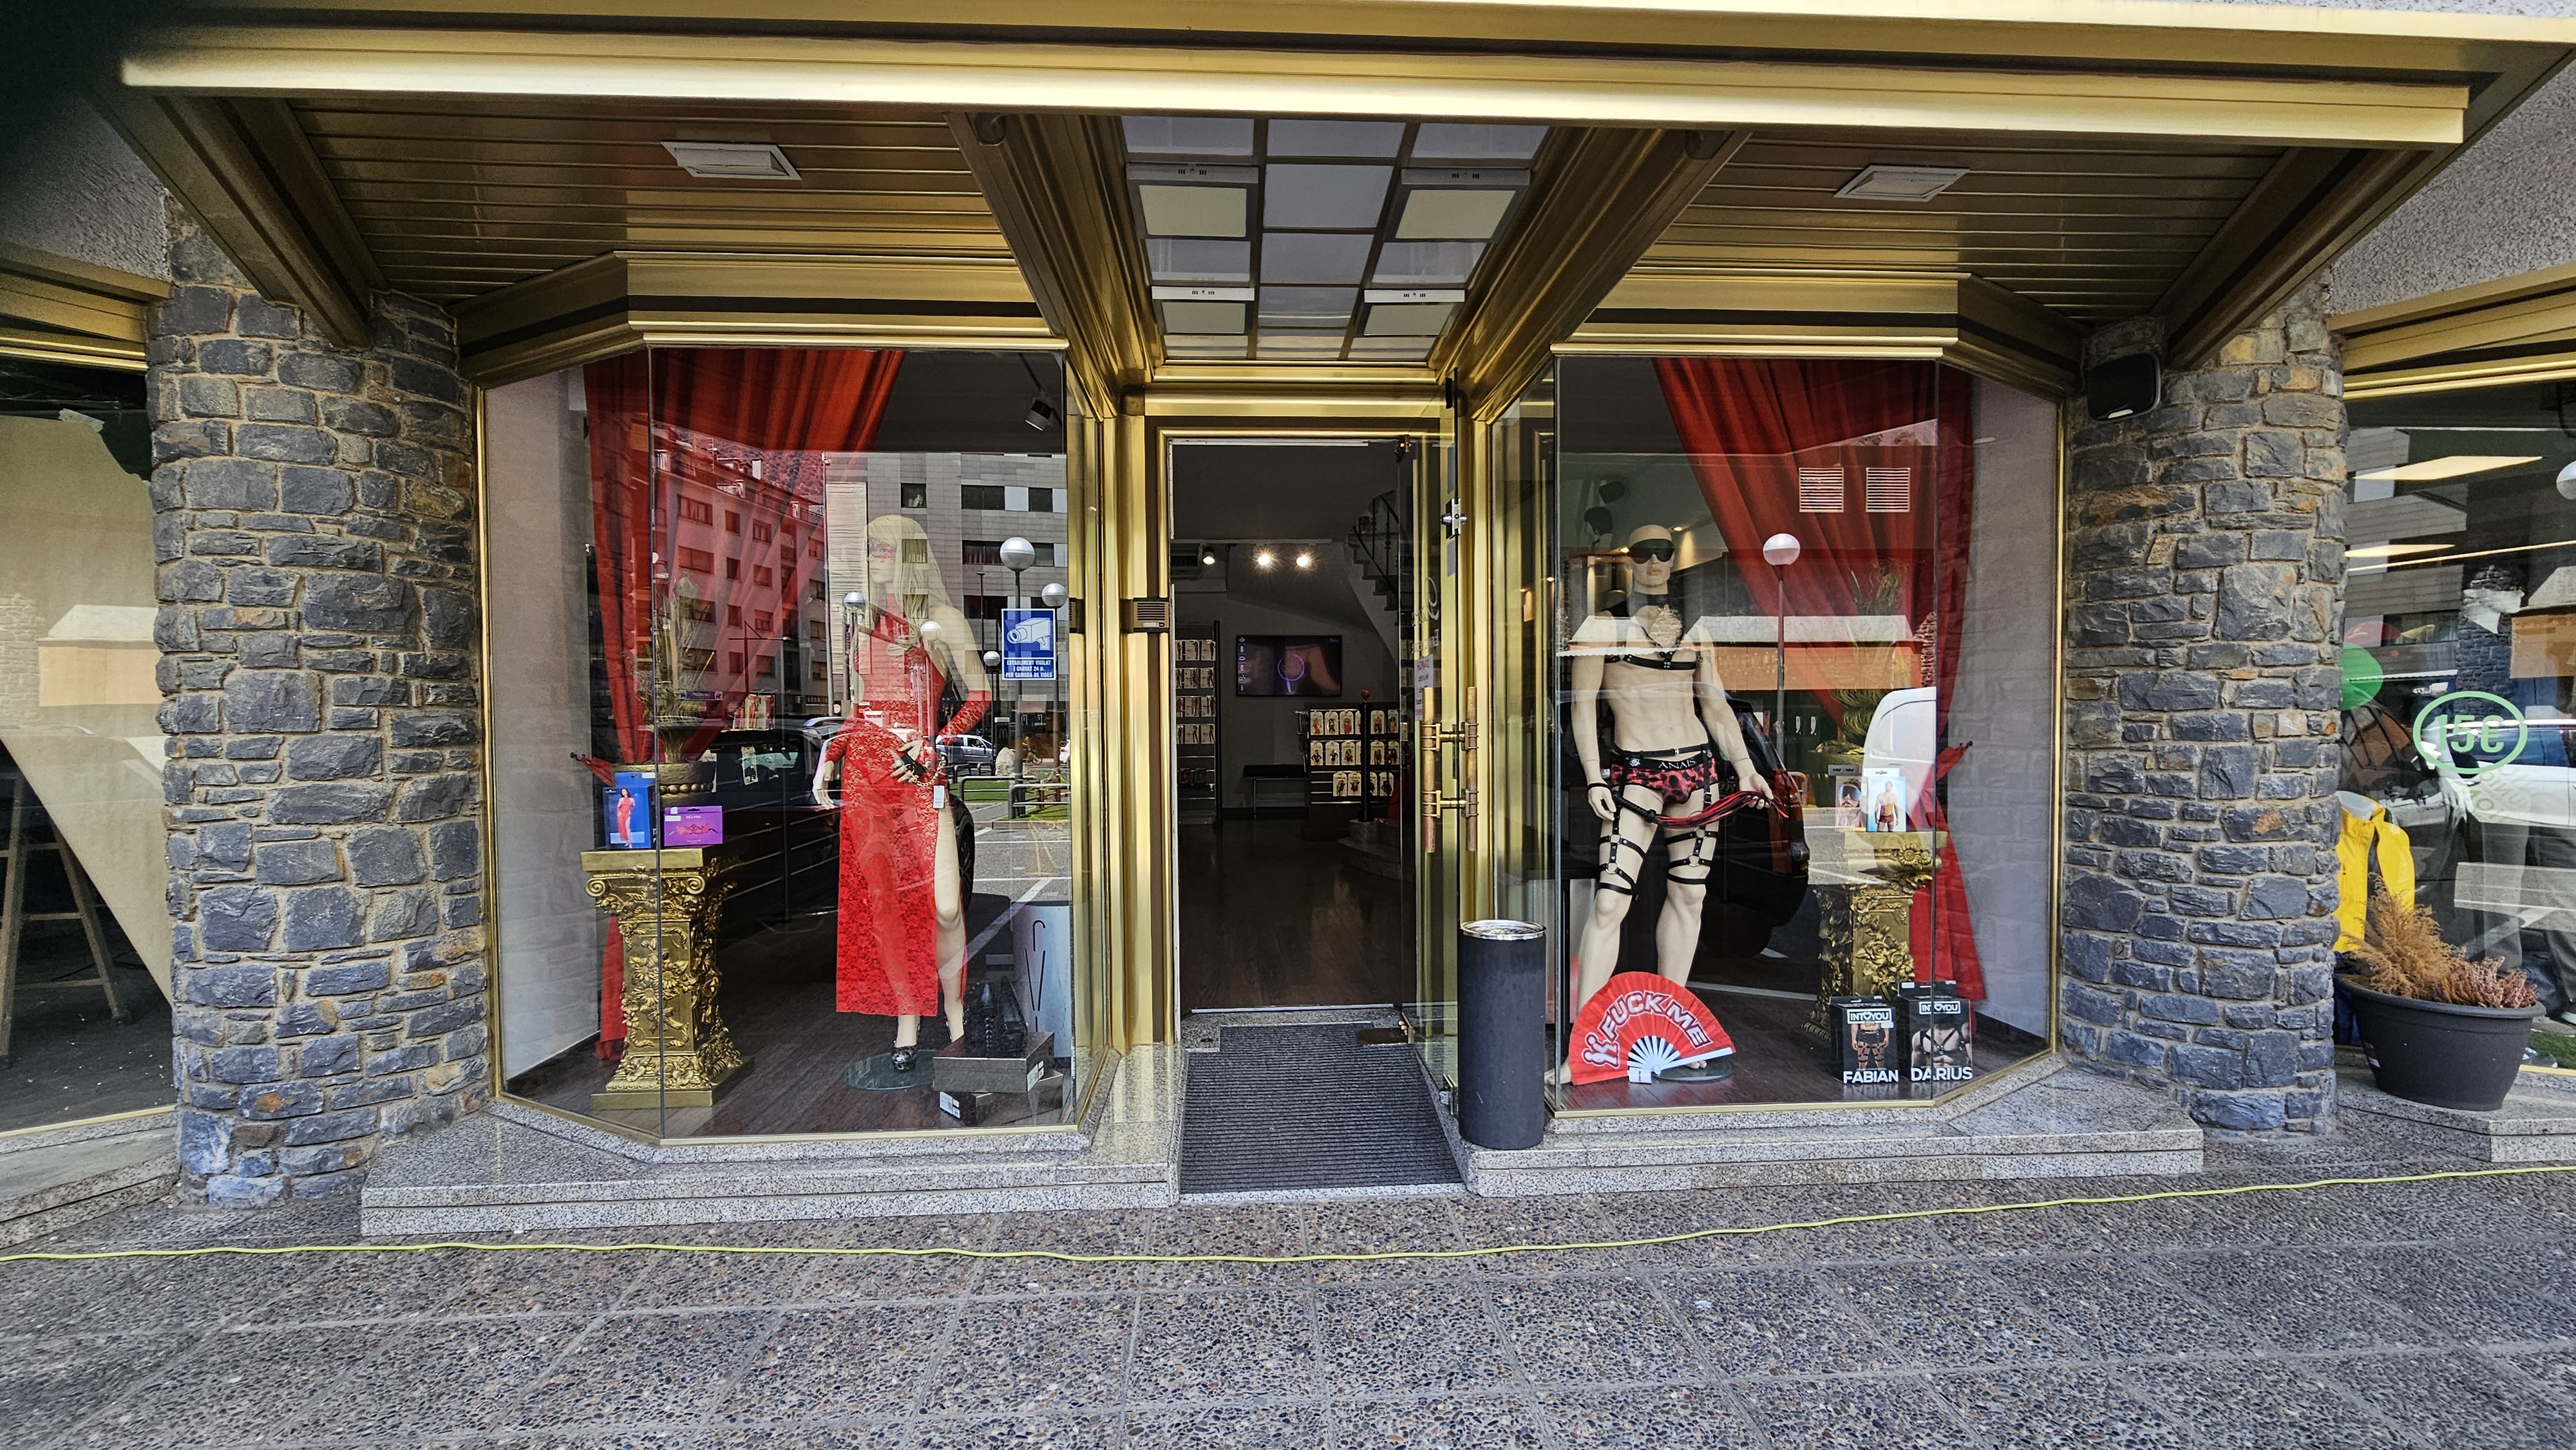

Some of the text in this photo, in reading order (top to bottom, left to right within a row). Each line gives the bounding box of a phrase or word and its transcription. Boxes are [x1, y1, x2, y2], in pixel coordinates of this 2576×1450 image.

[1658, 758, 1696, 769] ANAIS
[1598, 990, 1713, 1049] FUCK ME
[1843, 1069, 1899, 1084] FABIAN
[1911, 1066, 1973, 1082] DARIUS
